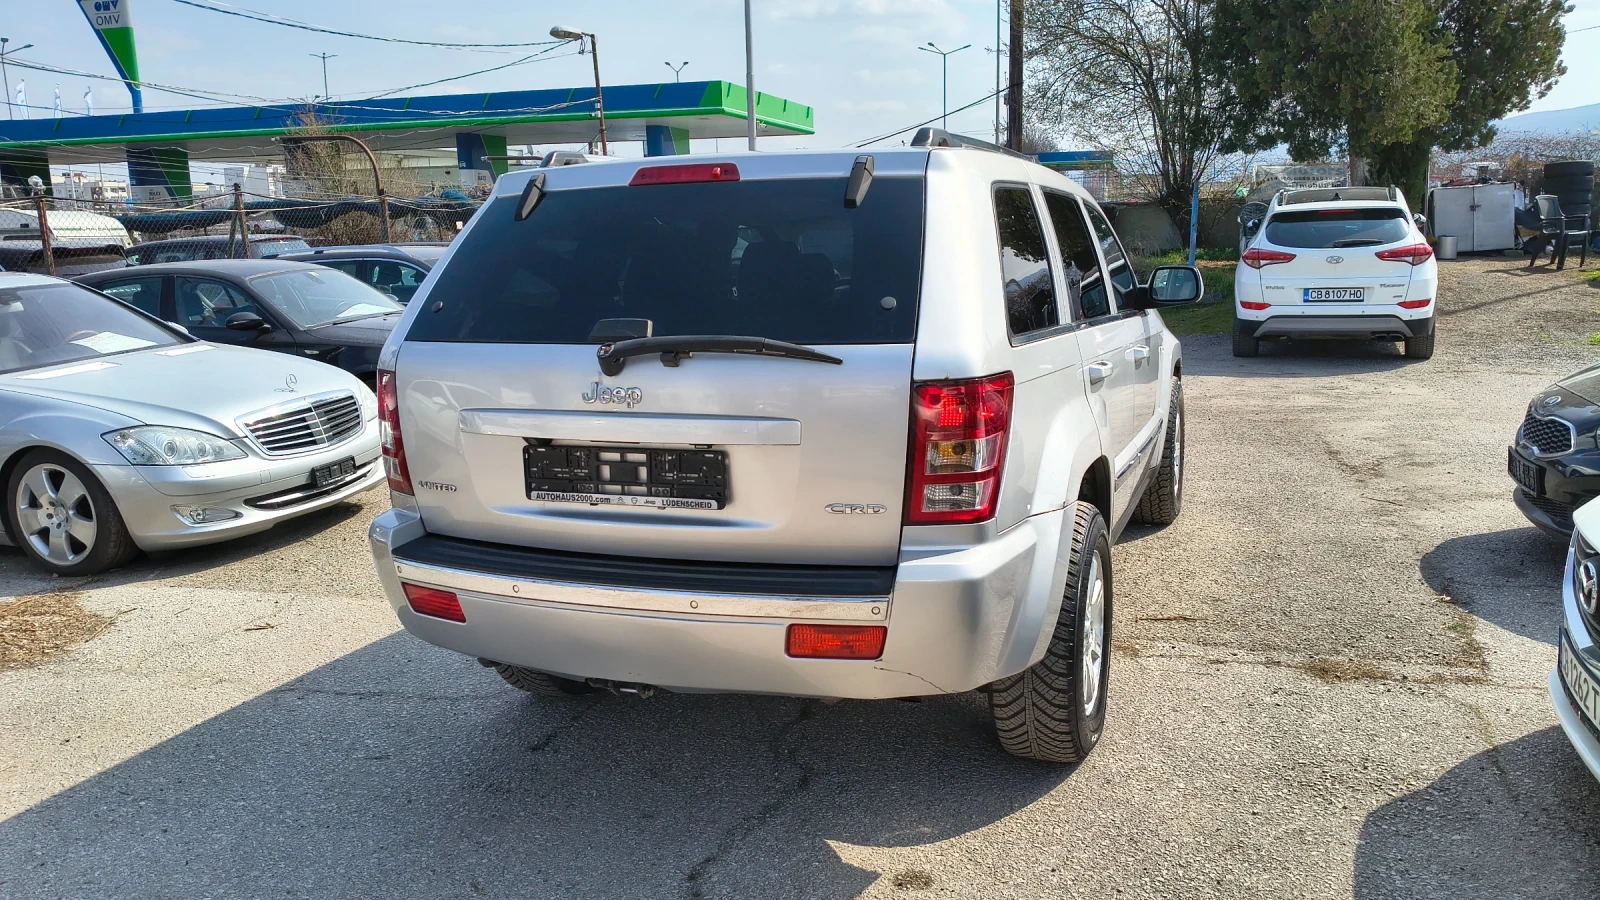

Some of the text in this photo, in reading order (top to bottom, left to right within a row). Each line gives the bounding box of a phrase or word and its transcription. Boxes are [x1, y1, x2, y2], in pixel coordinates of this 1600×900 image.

[95, 14, 120, 26] OMV
[1310, 290, 1323, 299] CB
[1324, 290, 1348, 299] 8107
[581, 381, 643, 409] Jeep
[536, 492, 611, 504] AUTOHAUS2000.com
[661, 499, 712, 509] LÜDENSCHEID
[824, 502, 887, 515] CRD
